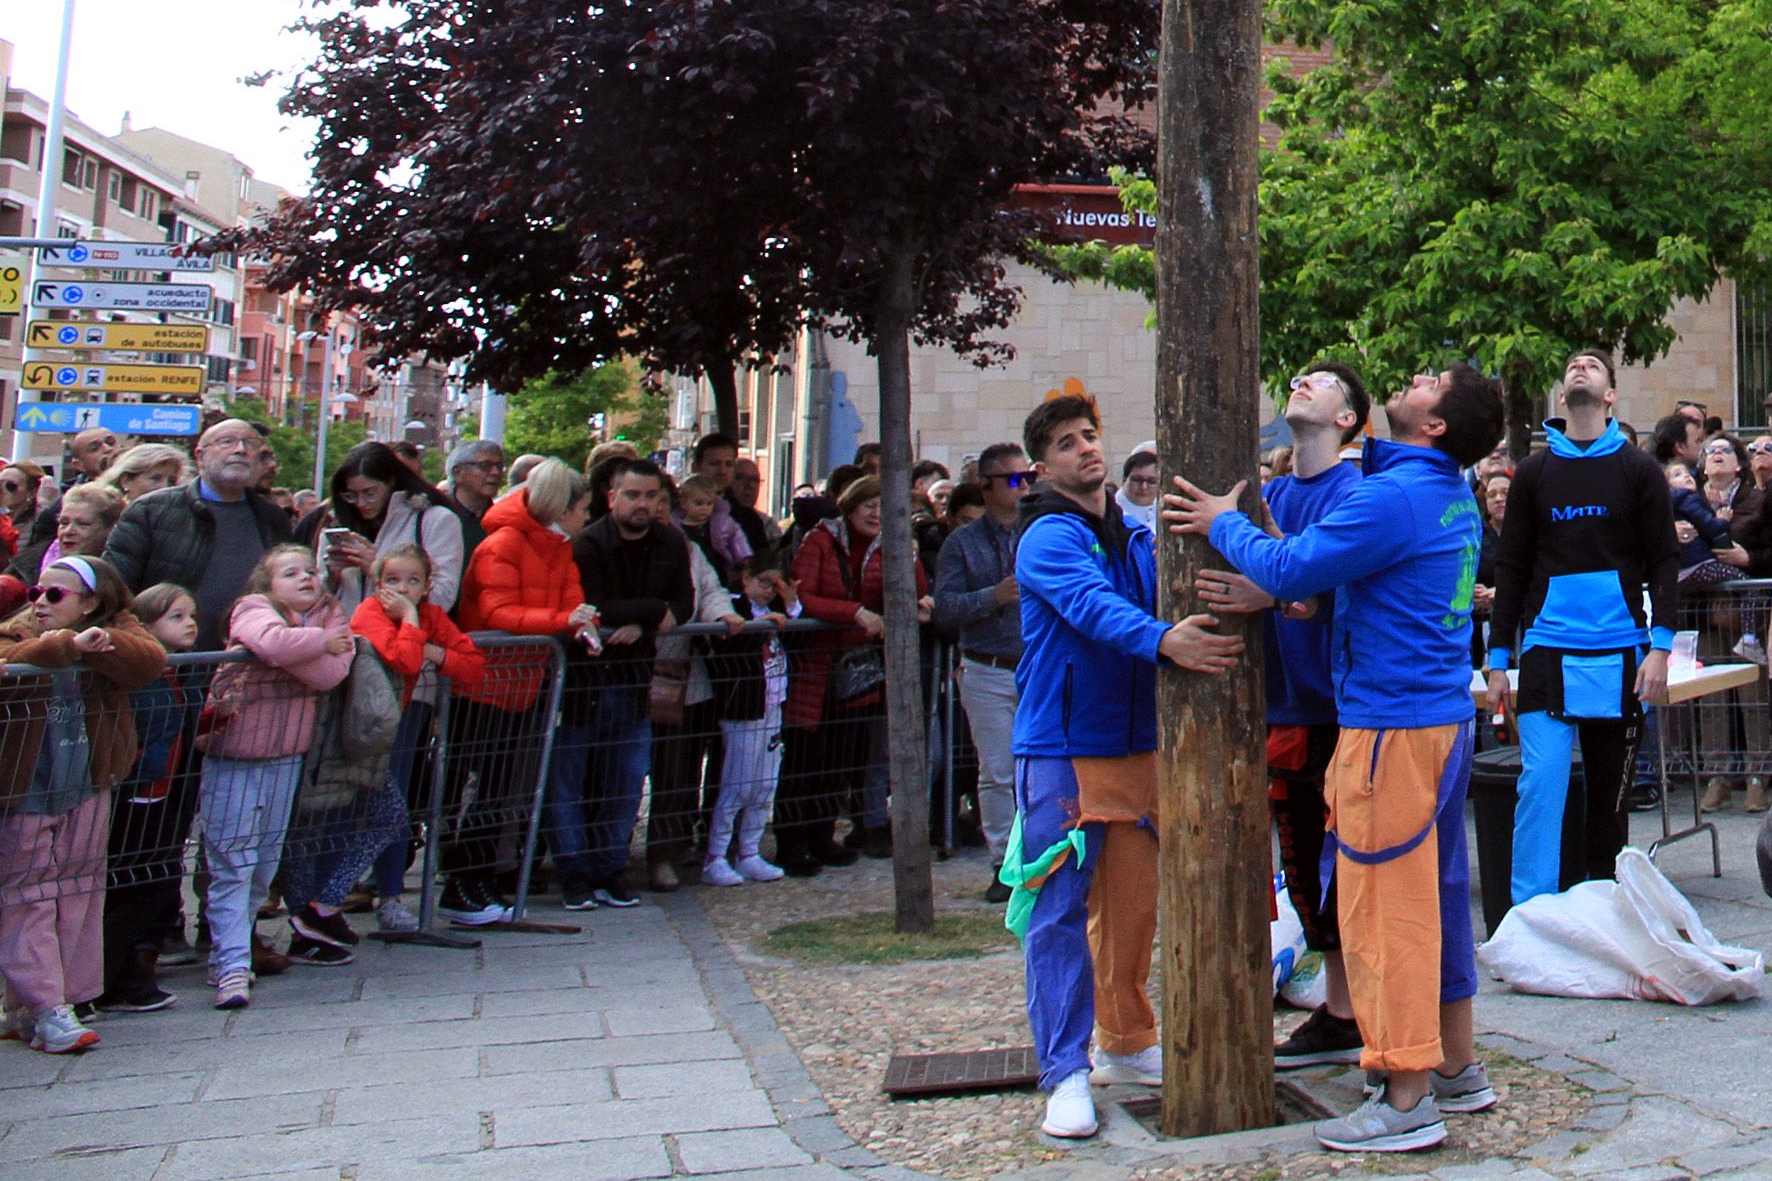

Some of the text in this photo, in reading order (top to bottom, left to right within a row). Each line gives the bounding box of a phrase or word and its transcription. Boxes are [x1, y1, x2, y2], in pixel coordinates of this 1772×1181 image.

[147, 289, 208, 298] acueducto
[113, 299, 206, 309] zona occidental
[154, 329, 203, 339] estación
[121, 339, 202, 349] de autobuses
[107, 375, 198, 385] estación RENFE
[153, 408, 192, 420] Camino
[128, 419, 191, 432] de Santiago
